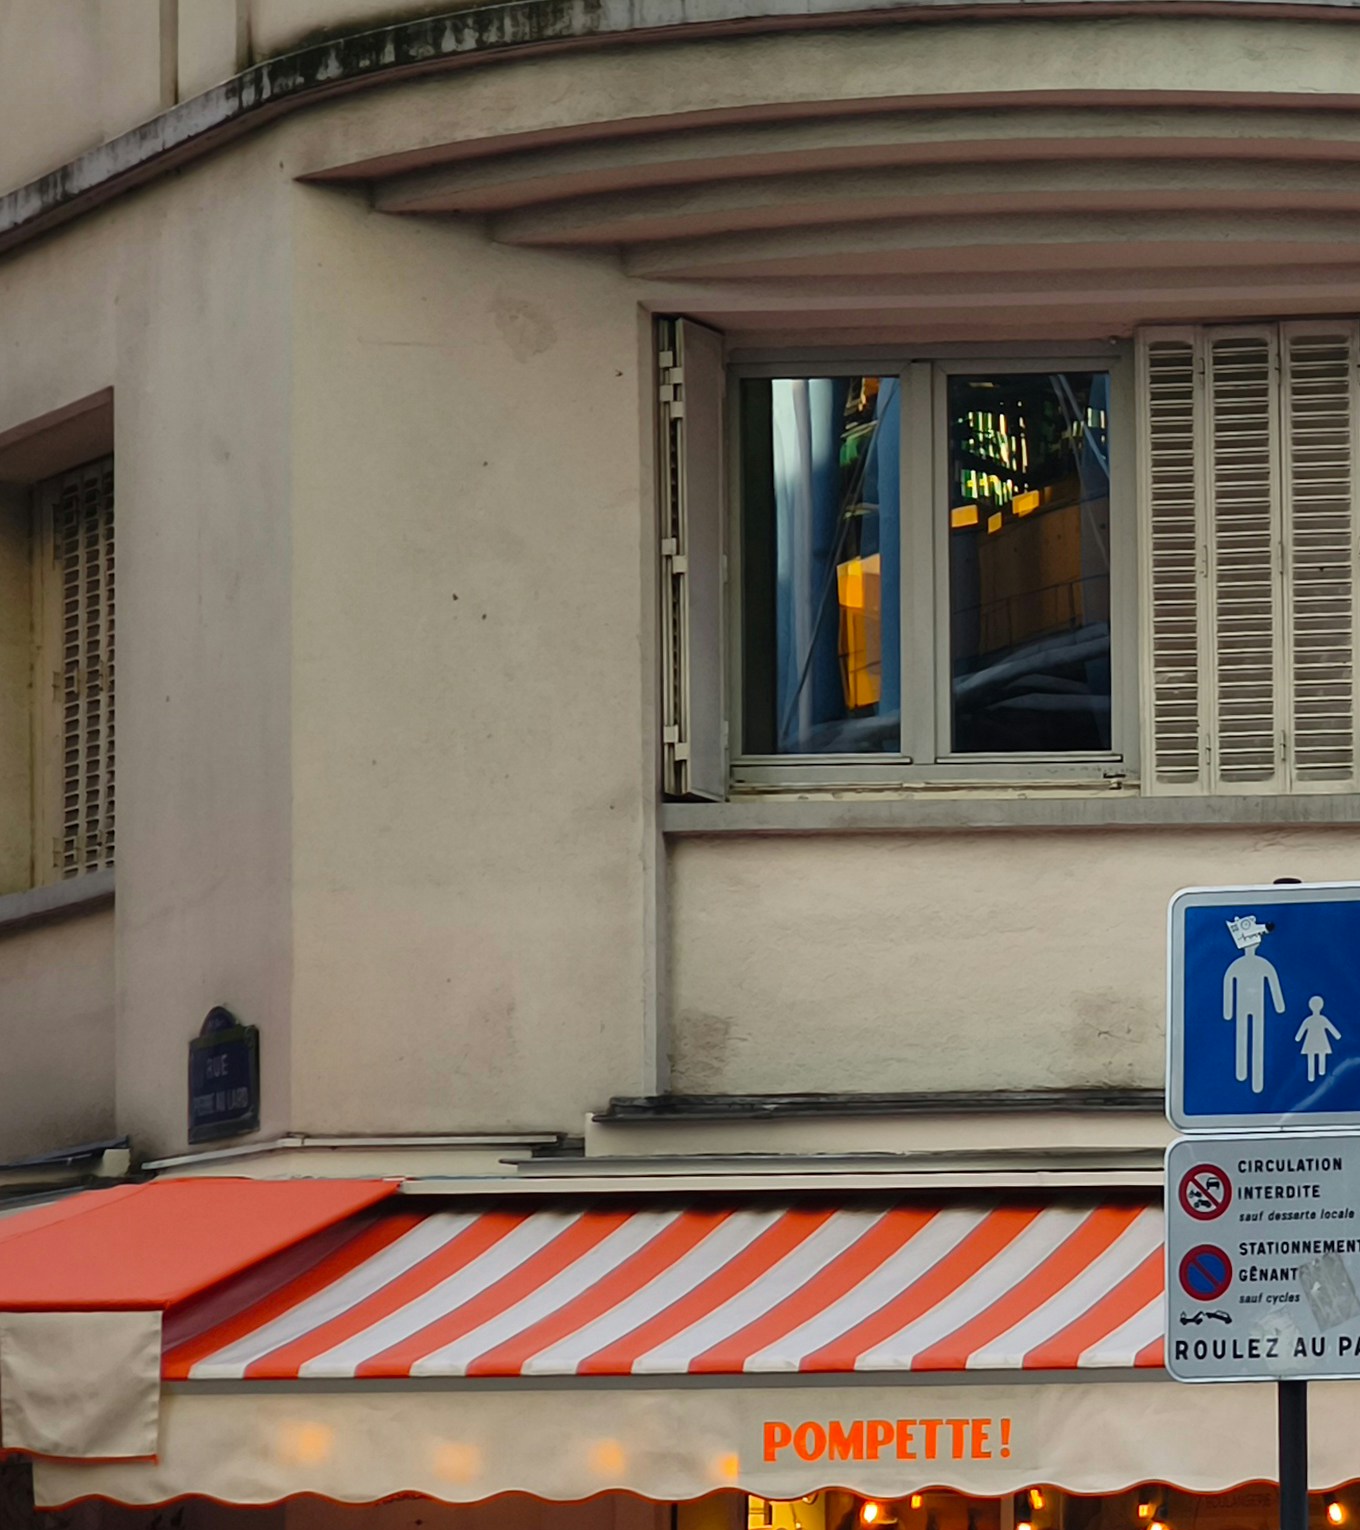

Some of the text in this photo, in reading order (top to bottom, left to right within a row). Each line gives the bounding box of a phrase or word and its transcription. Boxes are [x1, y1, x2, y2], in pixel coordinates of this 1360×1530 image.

[1237, 1157, 1343, 1173] CIRCULATION
[1237, 1184, 1321, 1200] INTERDITE
[1239, 1207, 1355, 1222] sauf desserte locale
[1238, 1265, 1299, 1282] GÊNANT
[1239, 1292, 1300, 1305] sauf cycles
[1175, 1338, 1280, 1360] ROULEZ
[1293, 1336, 1326, 1358] AU
[763, 1418, 1012, 1462] POMPETTE!
